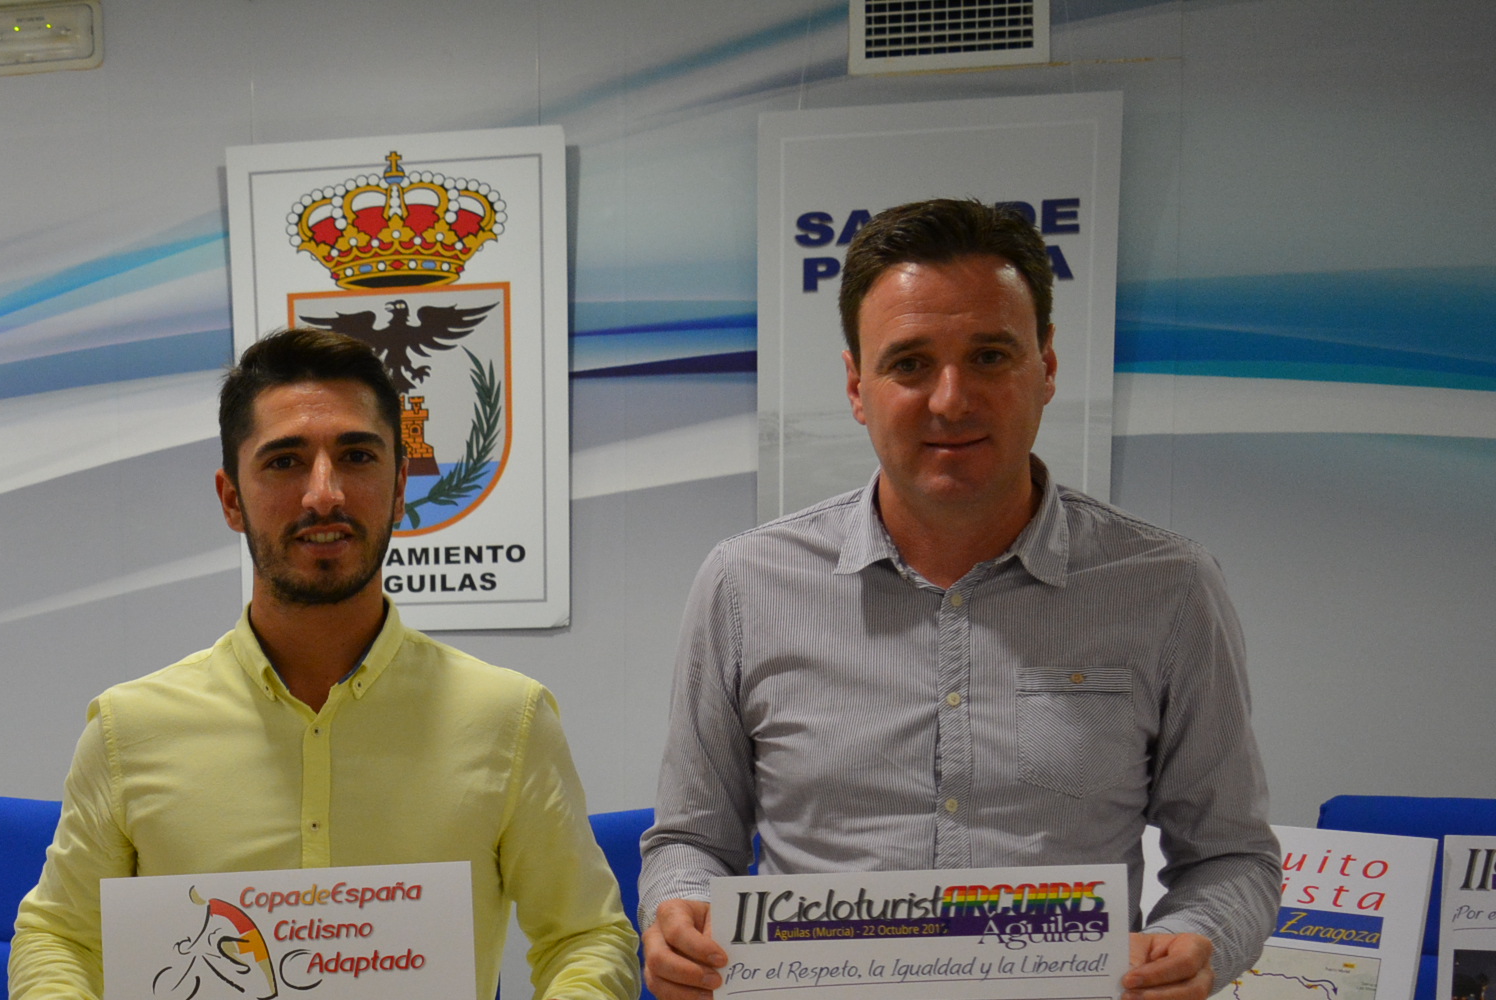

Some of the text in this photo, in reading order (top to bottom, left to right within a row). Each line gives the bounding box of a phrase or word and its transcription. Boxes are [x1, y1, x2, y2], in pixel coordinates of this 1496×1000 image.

[385, 544, 526, 567] AMIENTO
[384, 572, 498, 593] GUILAS
[1282, 849, 1389, 879] uito
[1281, 877, 1386, 911] ista
[272, 915, 373, 942] Ciclismo
[773, 926, 811, 939] Águilas
[812, 925, 854, 939] (Murcia)
[862, 925, 876, 936] 22
[877, 923, 919, 935] Octubre
[976, 908, 1105, 951] Águilas
[1279, 911, 1381, 944] Zaragoza
[305, 947, 425, 979] Adaptado
[722, 951, 1107, 985] ¡Por el Respeto, la Igualdad y la Libertad!
